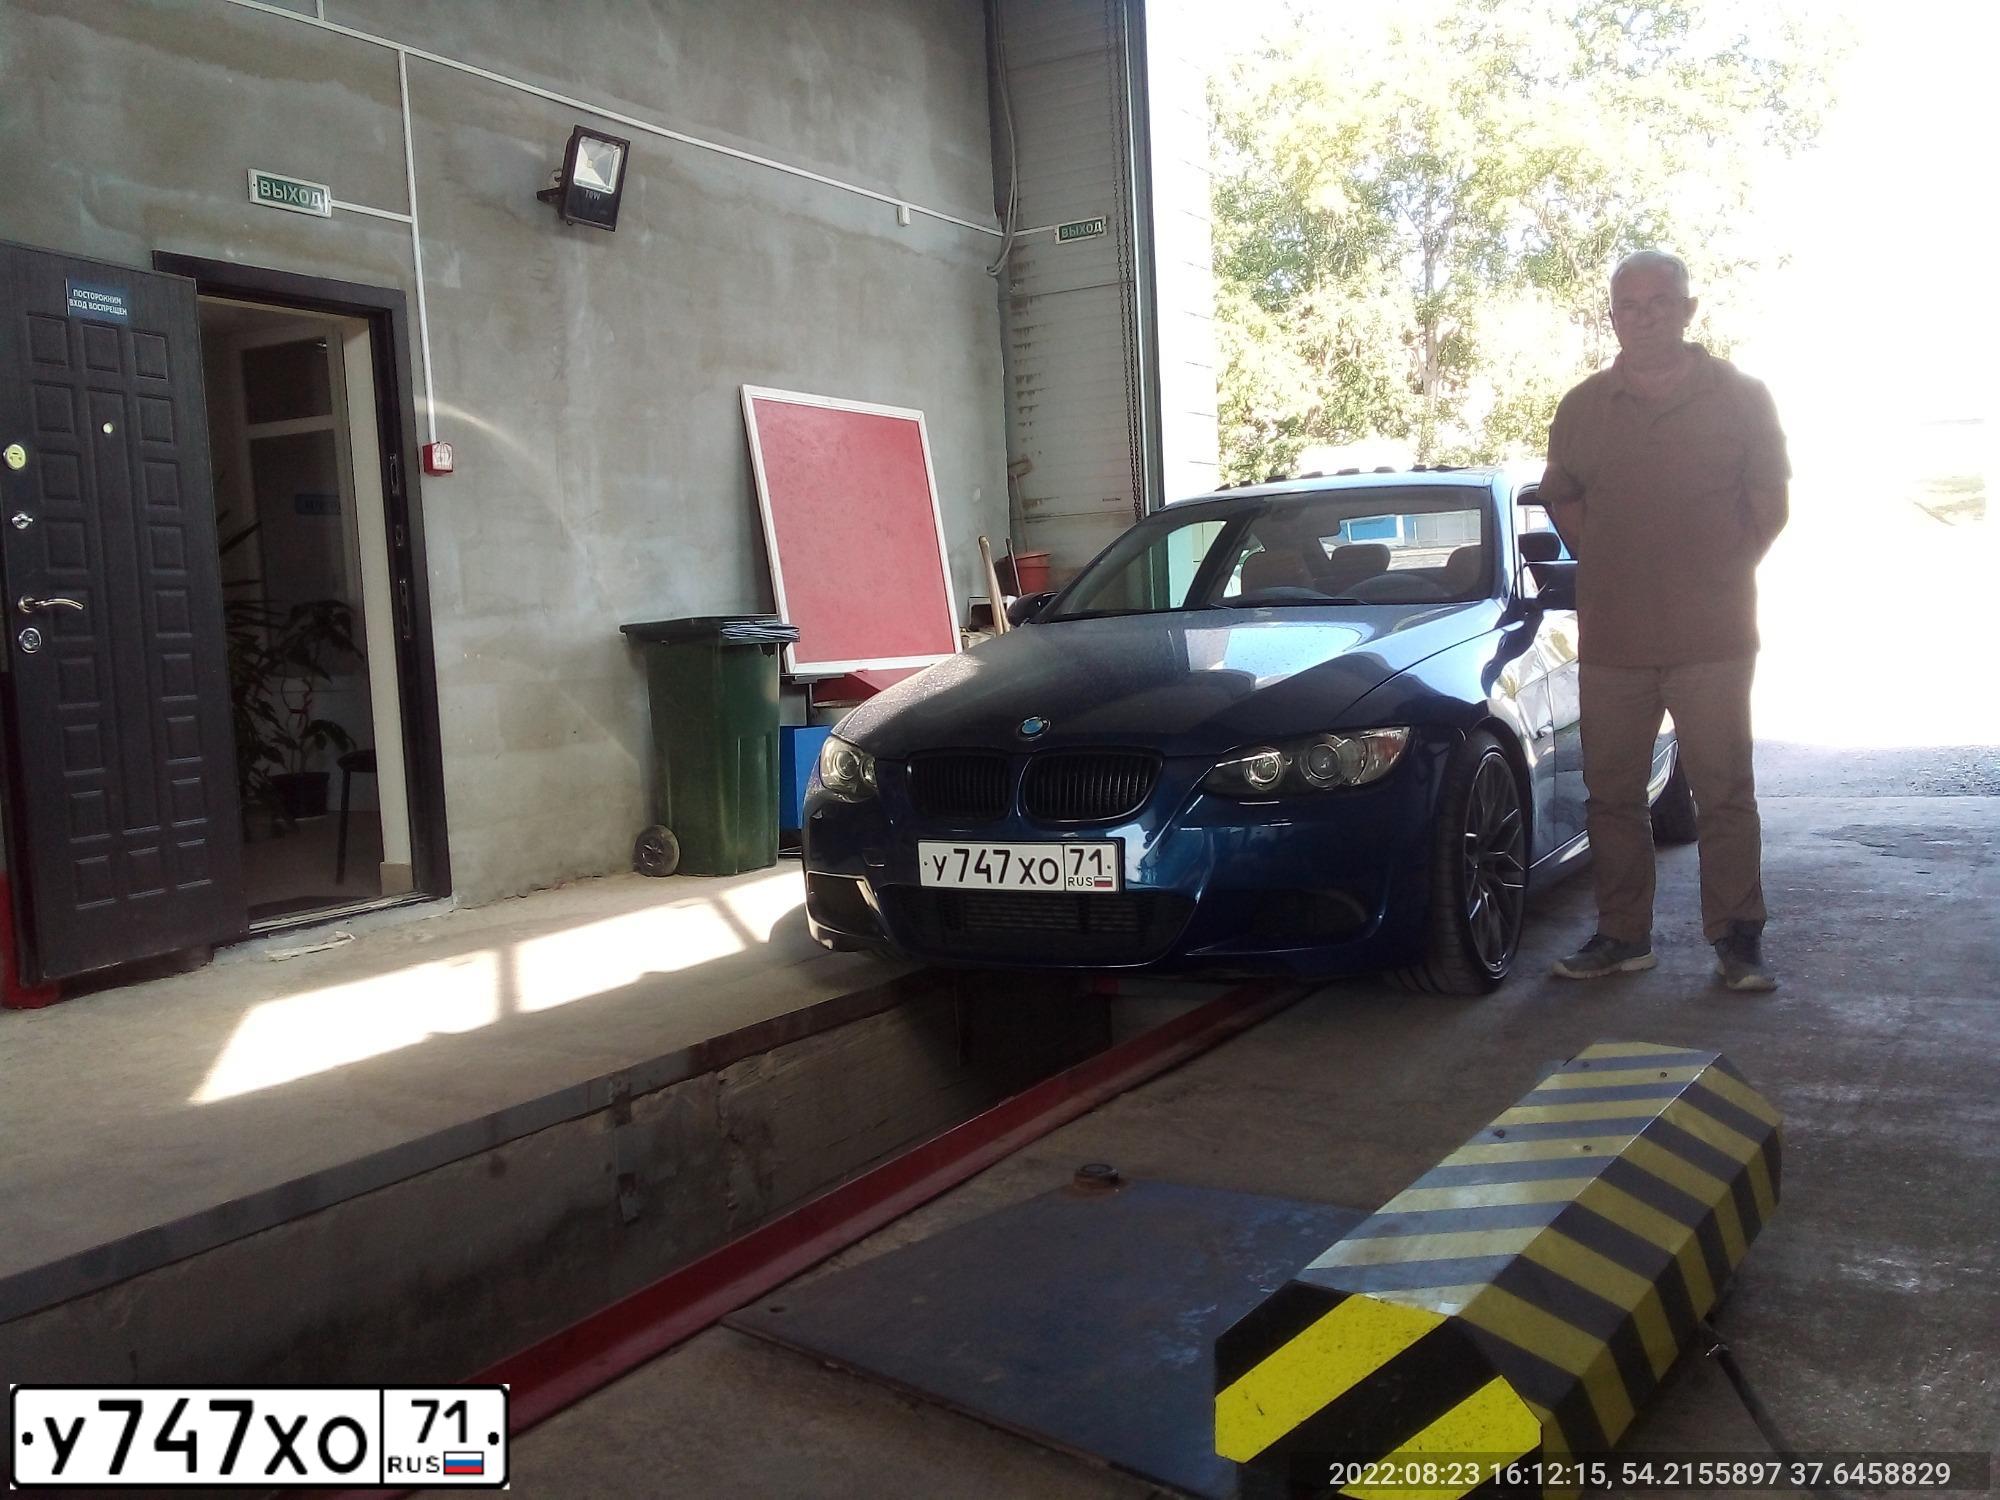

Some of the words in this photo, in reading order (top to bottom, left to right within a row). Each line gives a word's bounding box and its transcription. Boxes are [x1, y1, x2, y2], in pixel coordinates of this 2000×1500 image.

[260, 179, 326, 214] ВЫХОД
[1061, 221, 1103, 238] ВЫХОД
[73, 289, 122, 305] ПОСТОРОННИМ
[69, 298, 88, 310] ВХОД
[88, 301, 128, 316] ВОСПРЕЩЕН
[1069, 848, 1103, 876] 71
[1067, 877, 1093, 887] RUS
